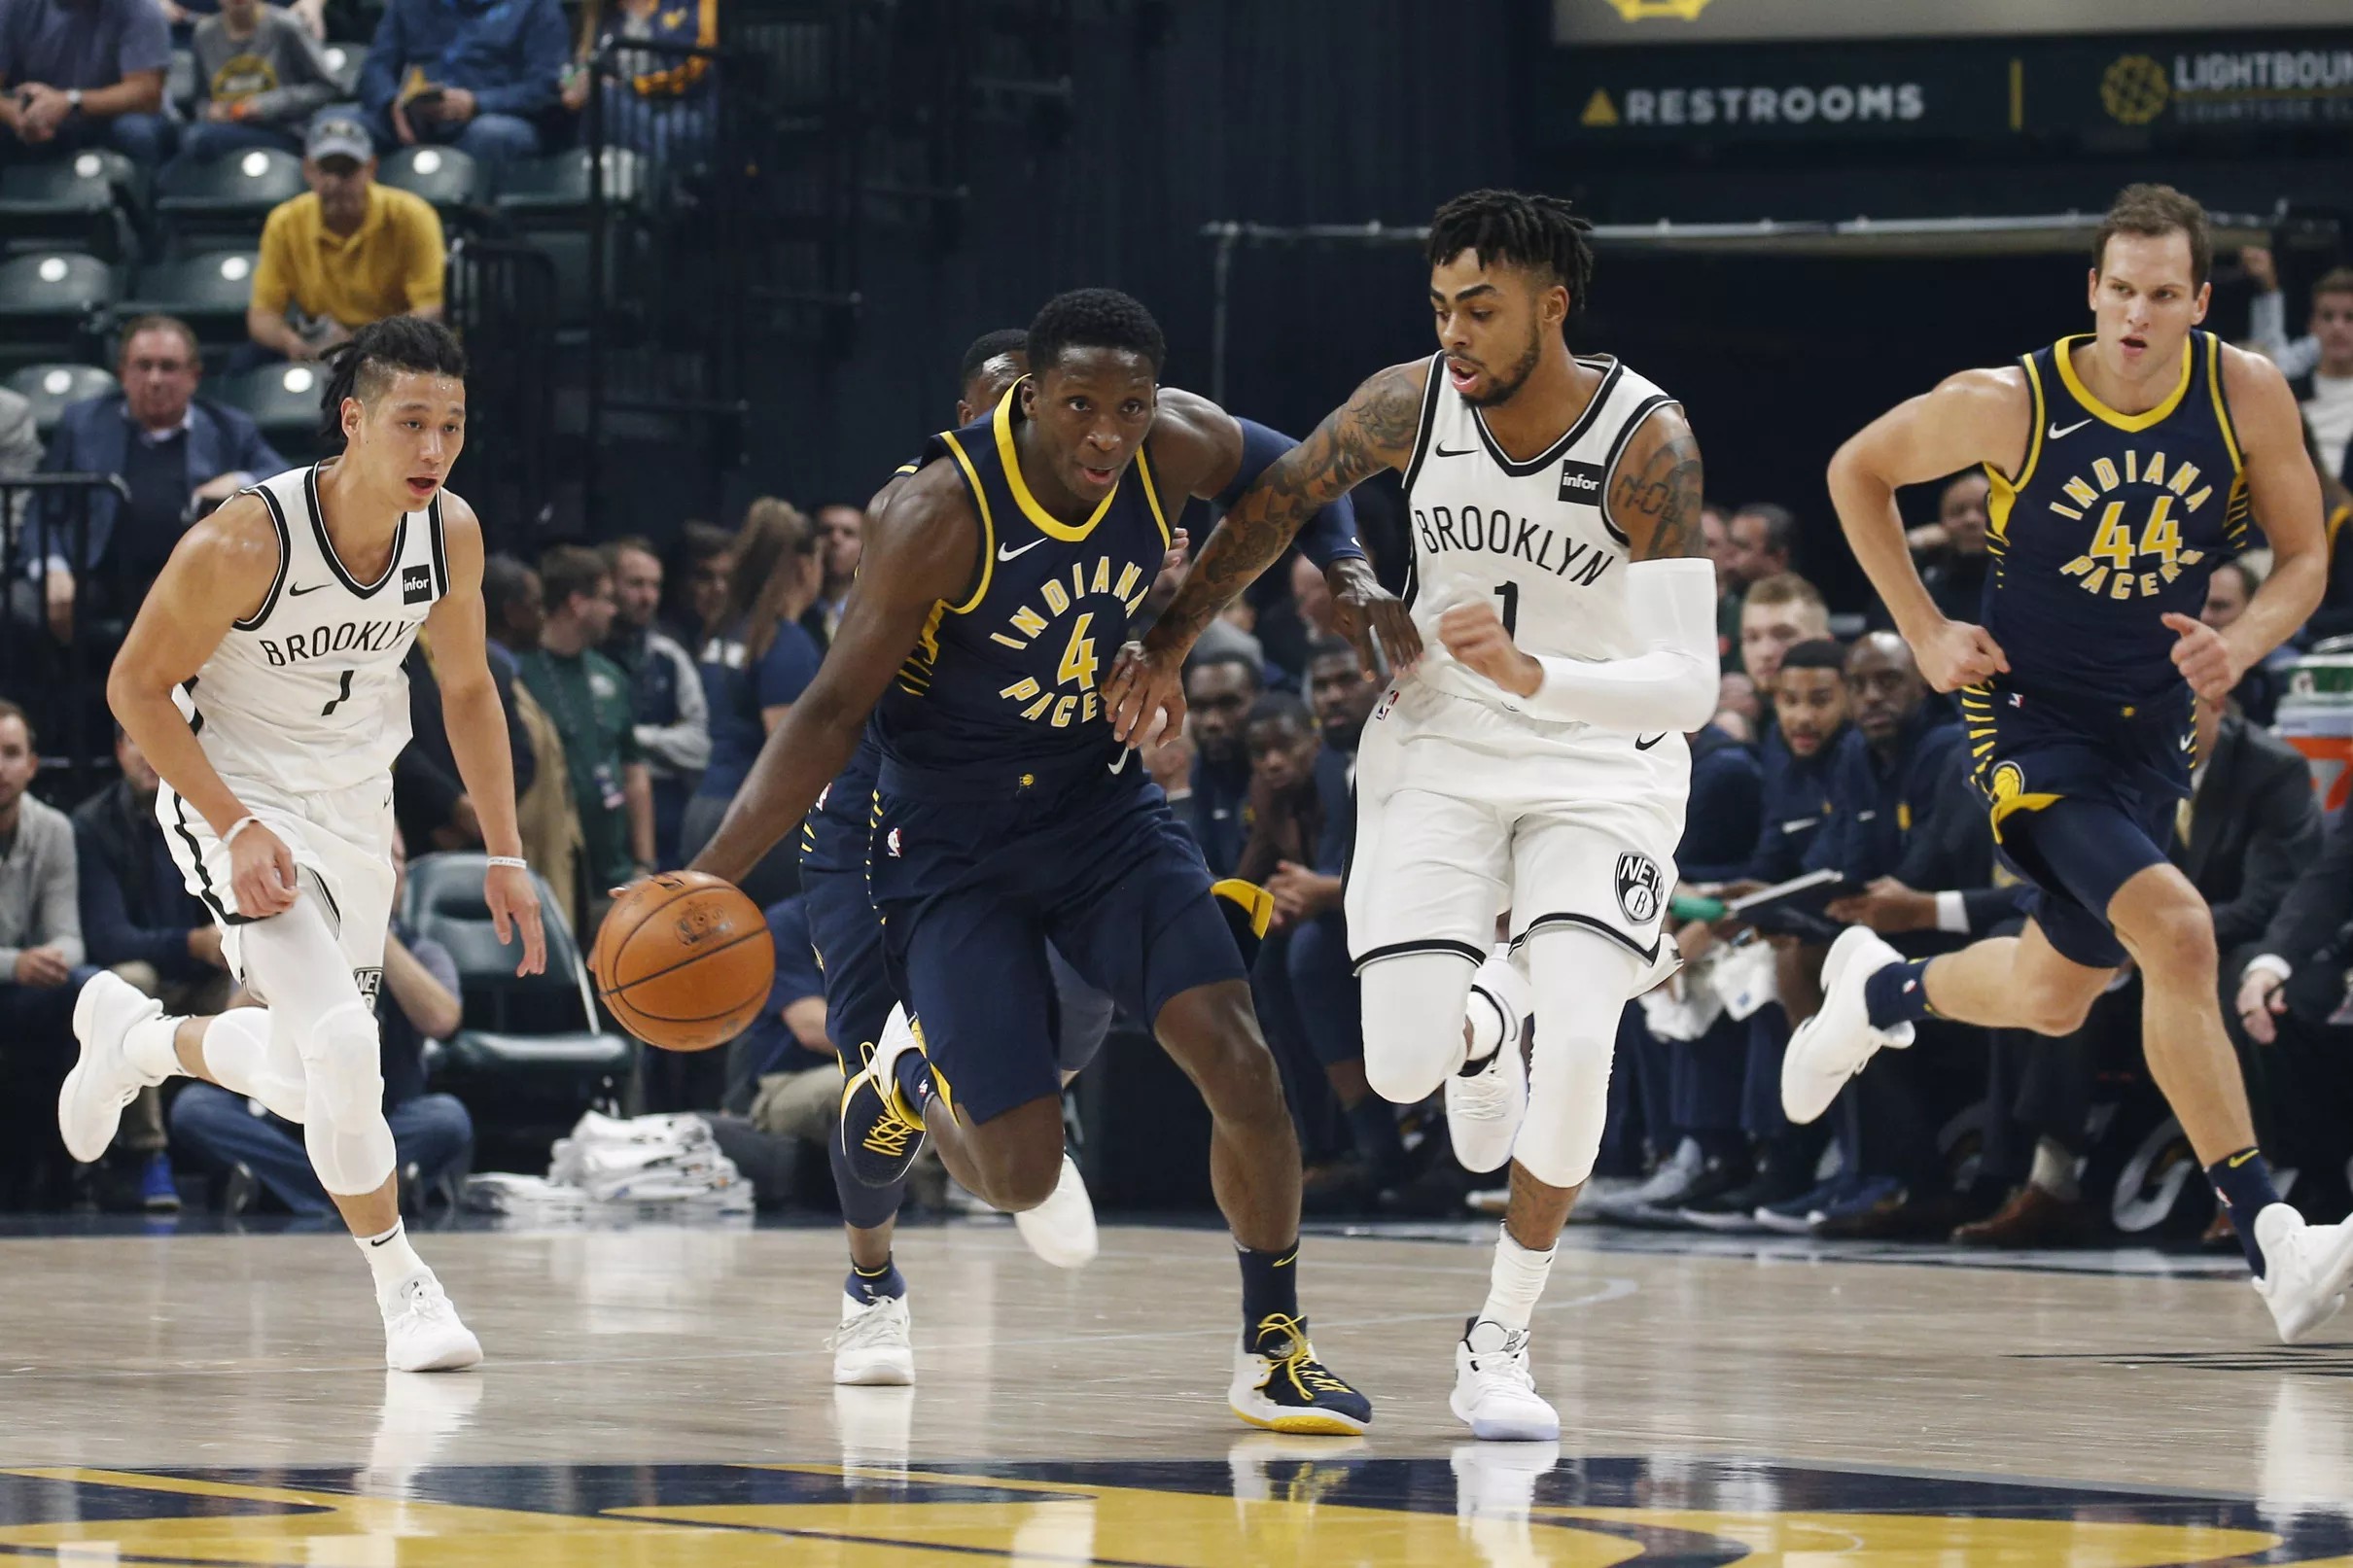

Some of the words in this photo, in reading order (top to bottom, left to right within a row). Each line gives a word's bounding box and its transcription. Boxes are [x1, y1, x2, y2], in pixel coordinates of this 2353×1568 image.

[1625, 84, 1924, 123] RESTROOMS
[1563, 471, 1598, 491] infor
[2049, 450, 2213, 521] INDIANA
[1414, 505, 1614, 587] BROOKLYN
[2090, 495, 2183, 570] 44
[404, 576, 429, 592] infor
[989, 556, 1149, 650] INDIANA
[1493, 579, 1519, 642] 1
[259, 620, 415, 667] BROOKLY
[1057, 611, 1099, 692] 4
[999, 676, 1099, 728] PACE
[1619, 856, 1663, 905] NETS
